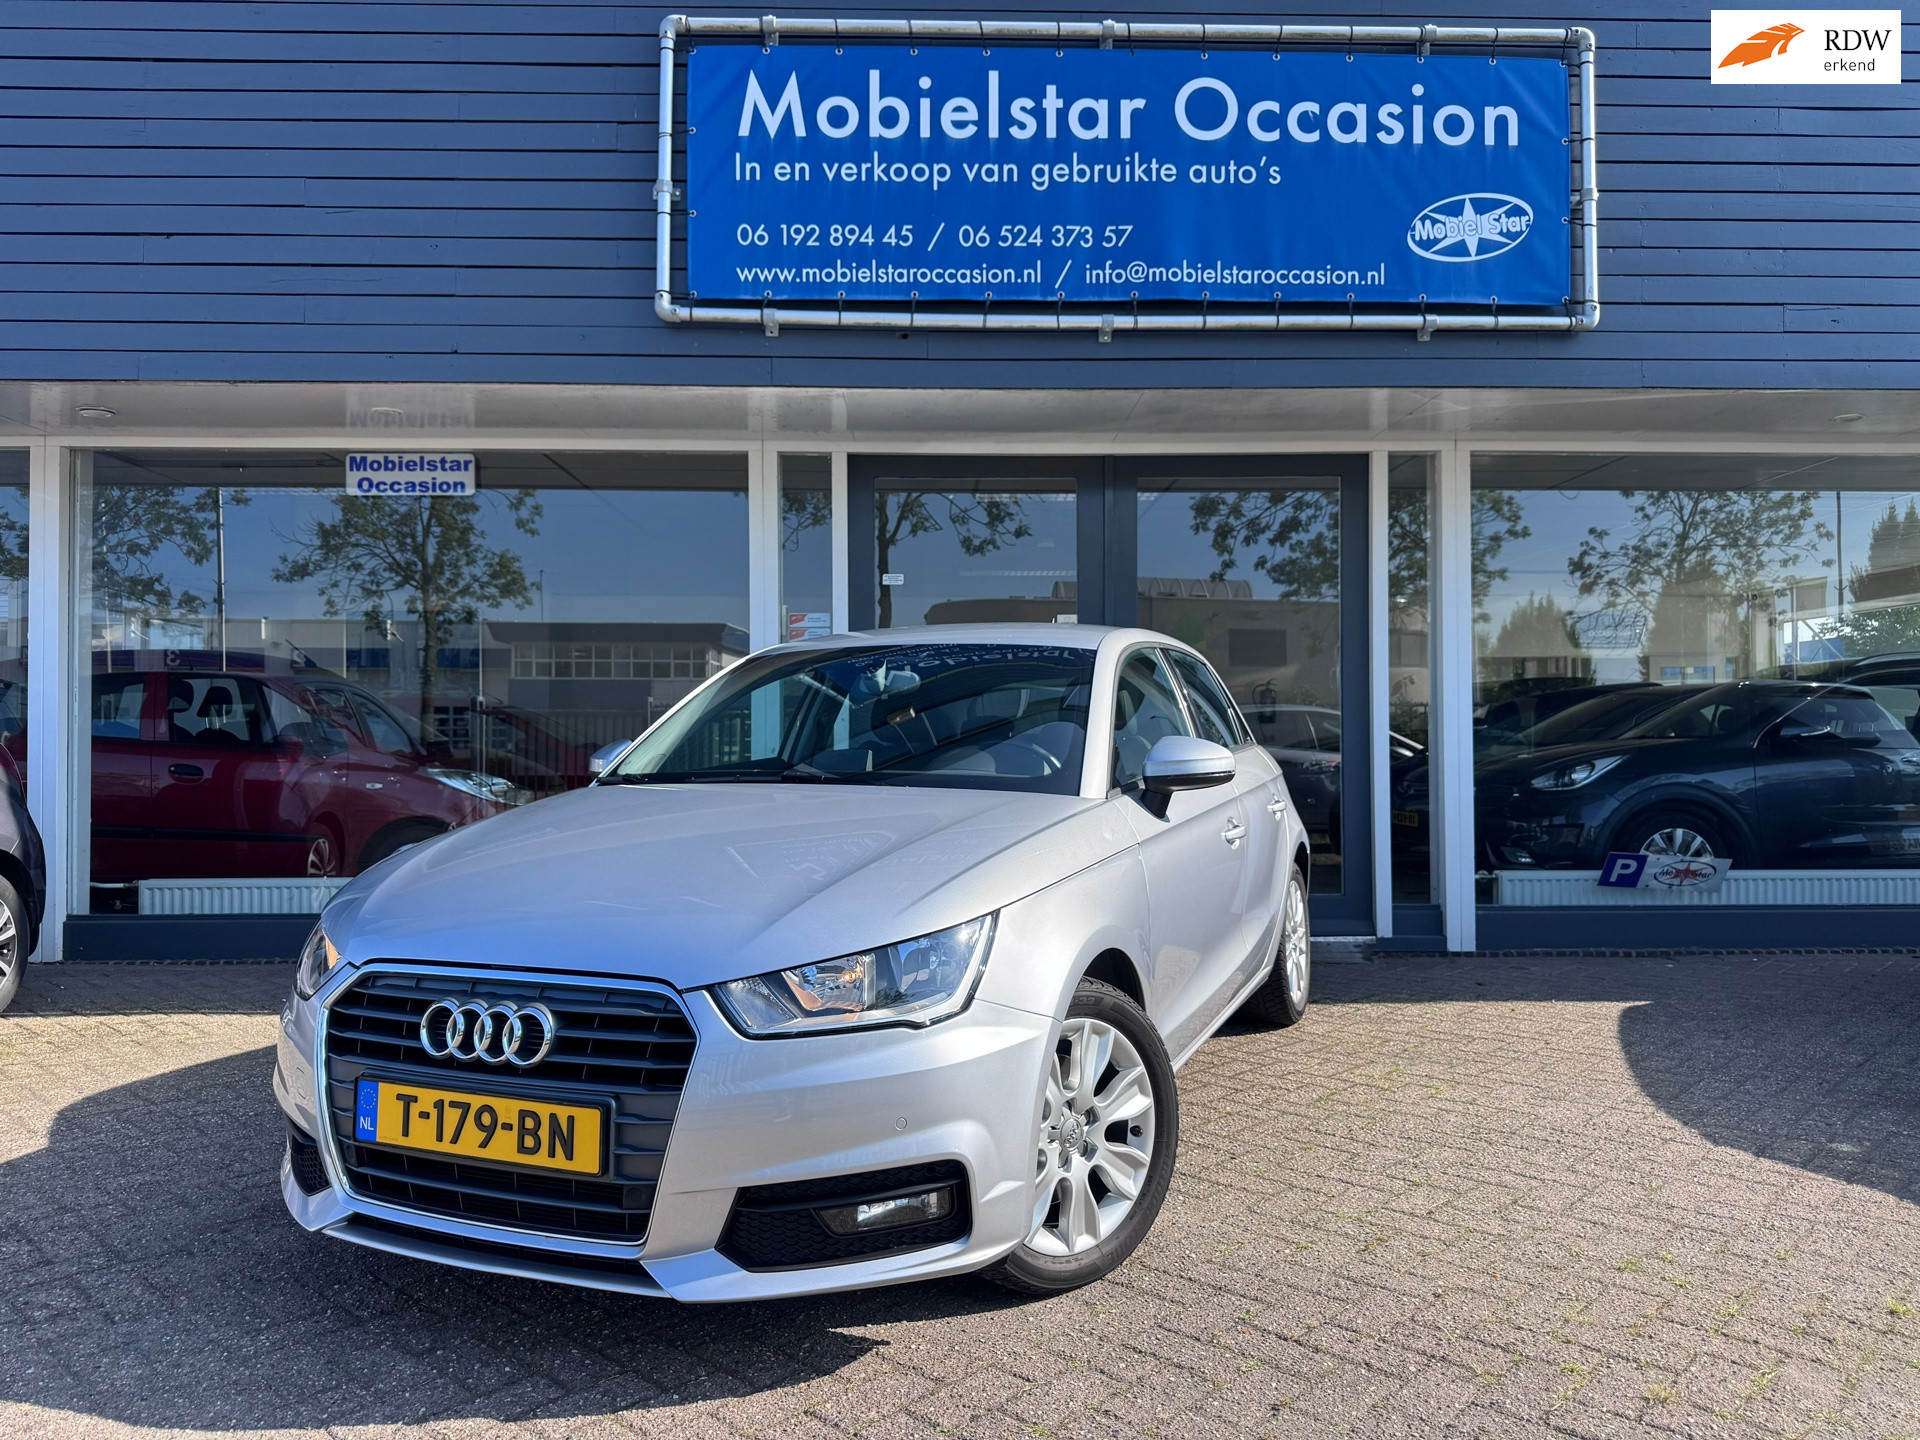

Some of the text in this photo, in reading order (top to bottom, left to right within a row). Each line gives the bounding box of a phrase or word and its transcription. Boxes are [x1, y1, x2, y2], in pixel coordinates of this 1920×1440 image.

[738, 69, 1519, 146] Mobielstar Occasion
[735, 152, 1281, 191] In en verkoop van gebruikte auto’s
[737, 222, 1133, 252] 06 192 894 45 / 06 524 373 57
[1414, 212, 1530, 241] Mobiel Star
[736, 259, 1385, 289] www.mobielstaroccasion.nl / info@mobielstaroccasion.nl
[348, 455, 473, 473] Mobielstar
[356, 477, 466, 494] Occasion
[1608, 858, 1638, 882] P
[359, 1115, 375, 1131] NL
[395, 1093, 576, 1162] T-179-BN
